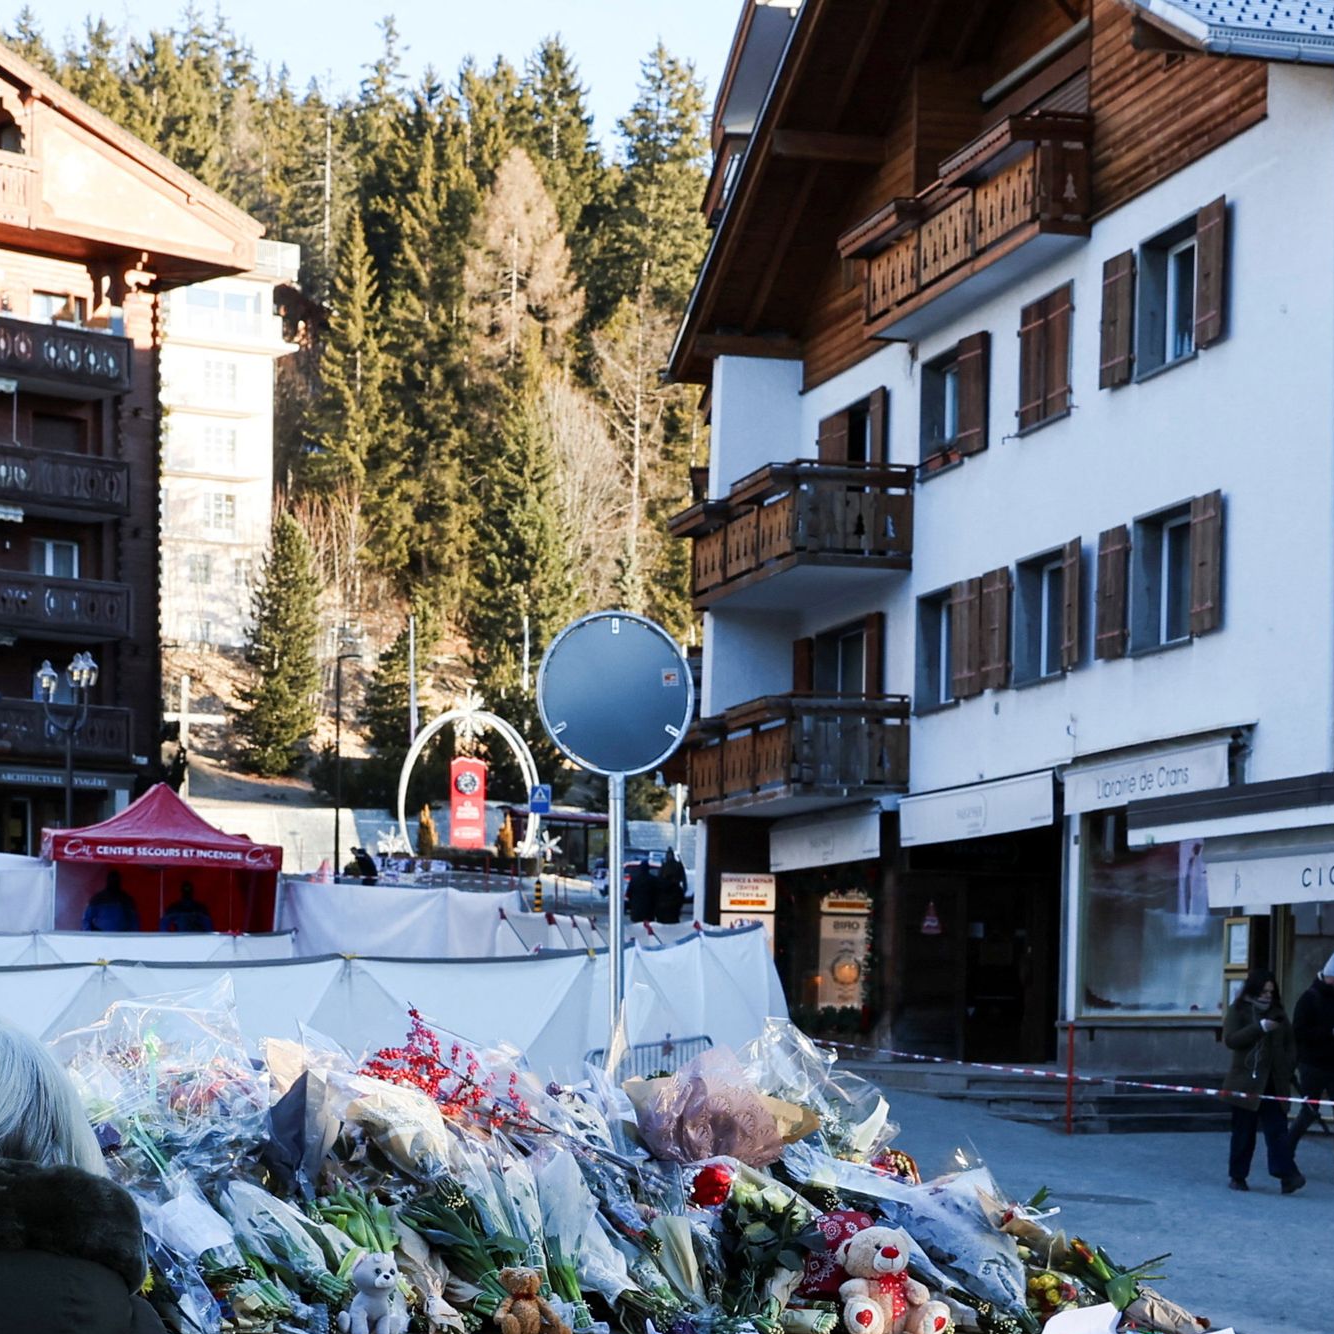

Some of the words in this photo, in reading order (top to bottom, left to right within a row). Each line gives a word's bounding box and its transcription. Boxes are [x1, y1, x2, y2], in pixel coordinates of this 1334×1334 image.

[1, 773, 63, 785] ARCHITECTURE
[1097, 776, 1136, 799] Librairie
[1139, 772, 1154, 791] de
[1157, 766, 1189, 788] Crans
[95, 845, 135, 857] CENTRE
[136, 847, 180, 859] SECOURS
[182, 849, 196, 858] ET
[196, 850, 243, 861] INCENDIE
